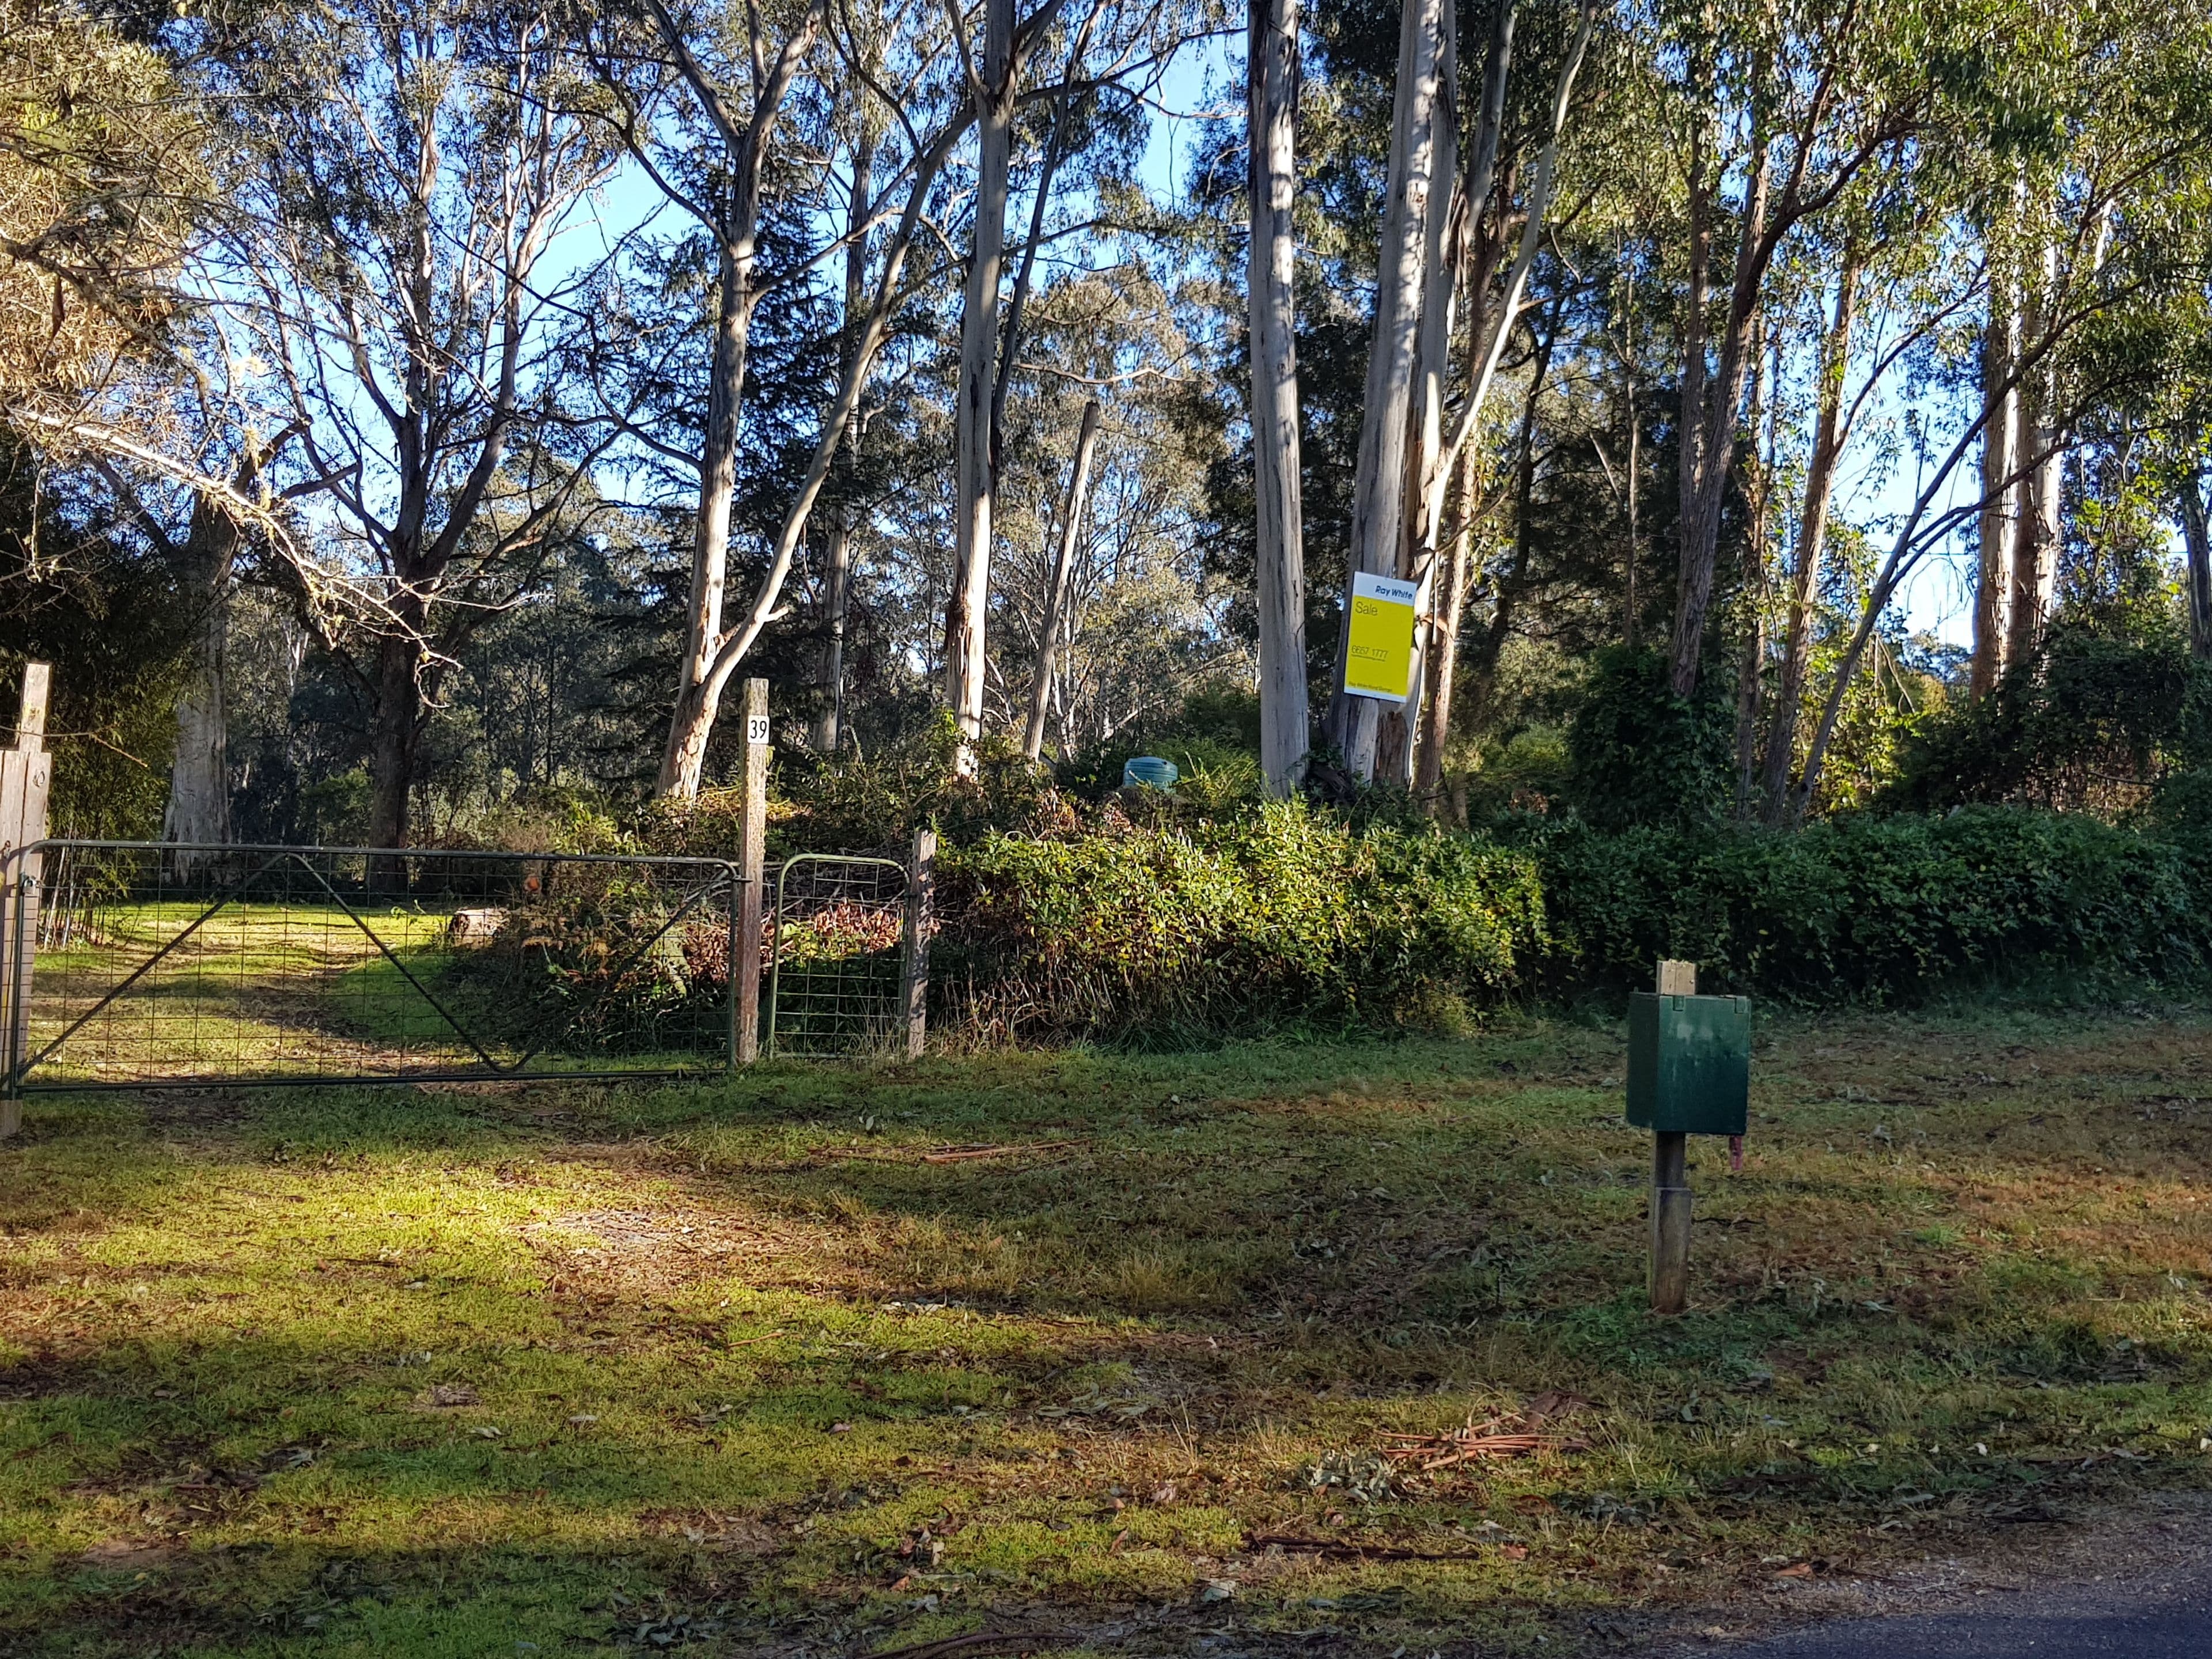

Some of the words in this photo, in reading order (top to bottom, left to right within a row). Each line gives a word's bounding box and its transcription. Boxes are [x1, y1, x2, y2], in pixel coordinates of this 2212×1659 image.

[1375, 585, 1391, 597] Ray
[1391, 588, 1413, 600] White
[1355, 601, 1378, 616] Sale
[749, 719, 767, 738] 39
